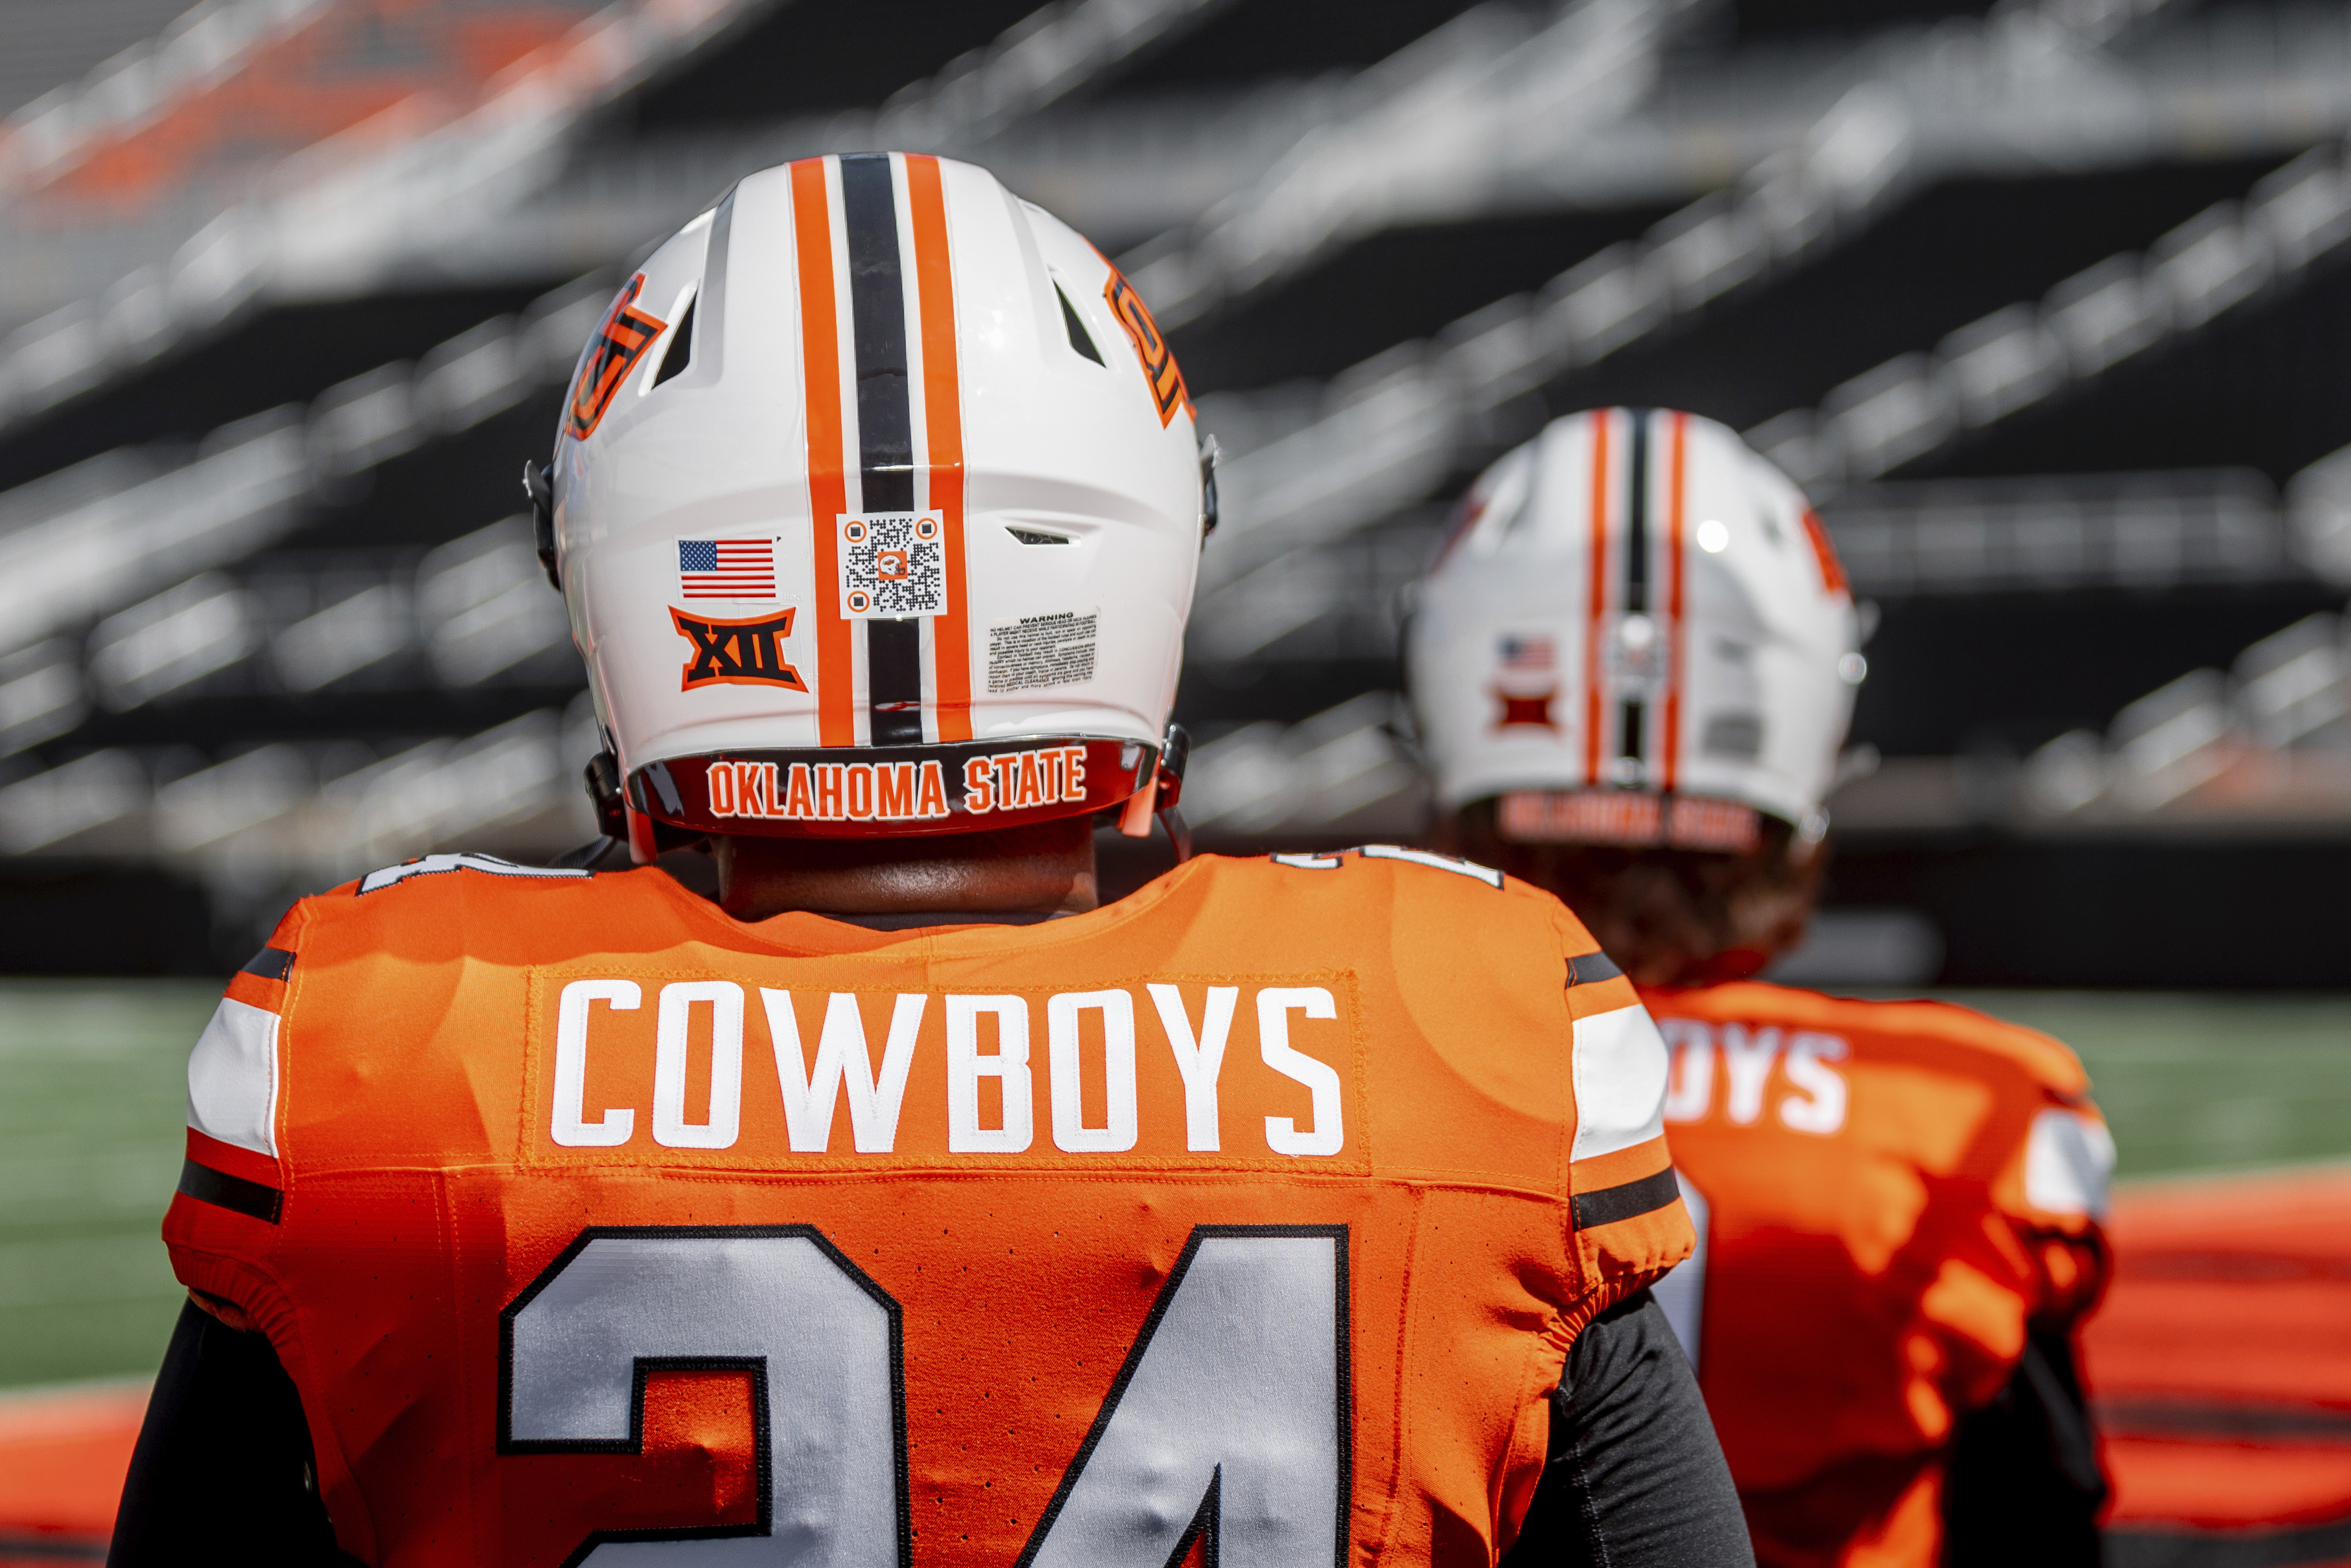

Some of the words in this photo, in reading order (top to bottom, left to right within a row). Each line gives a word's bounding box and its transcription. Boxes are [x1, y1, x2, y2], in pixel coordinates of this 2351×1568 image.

[677, 615, 797, 683] XII
[1020, 613, 1074, 624] WARNING
[707, 761, 950, 820] OKLAHOMA
[963, 746, 1088, 815] STATE
[550, 978, 1344, 1156] COWBOYS
